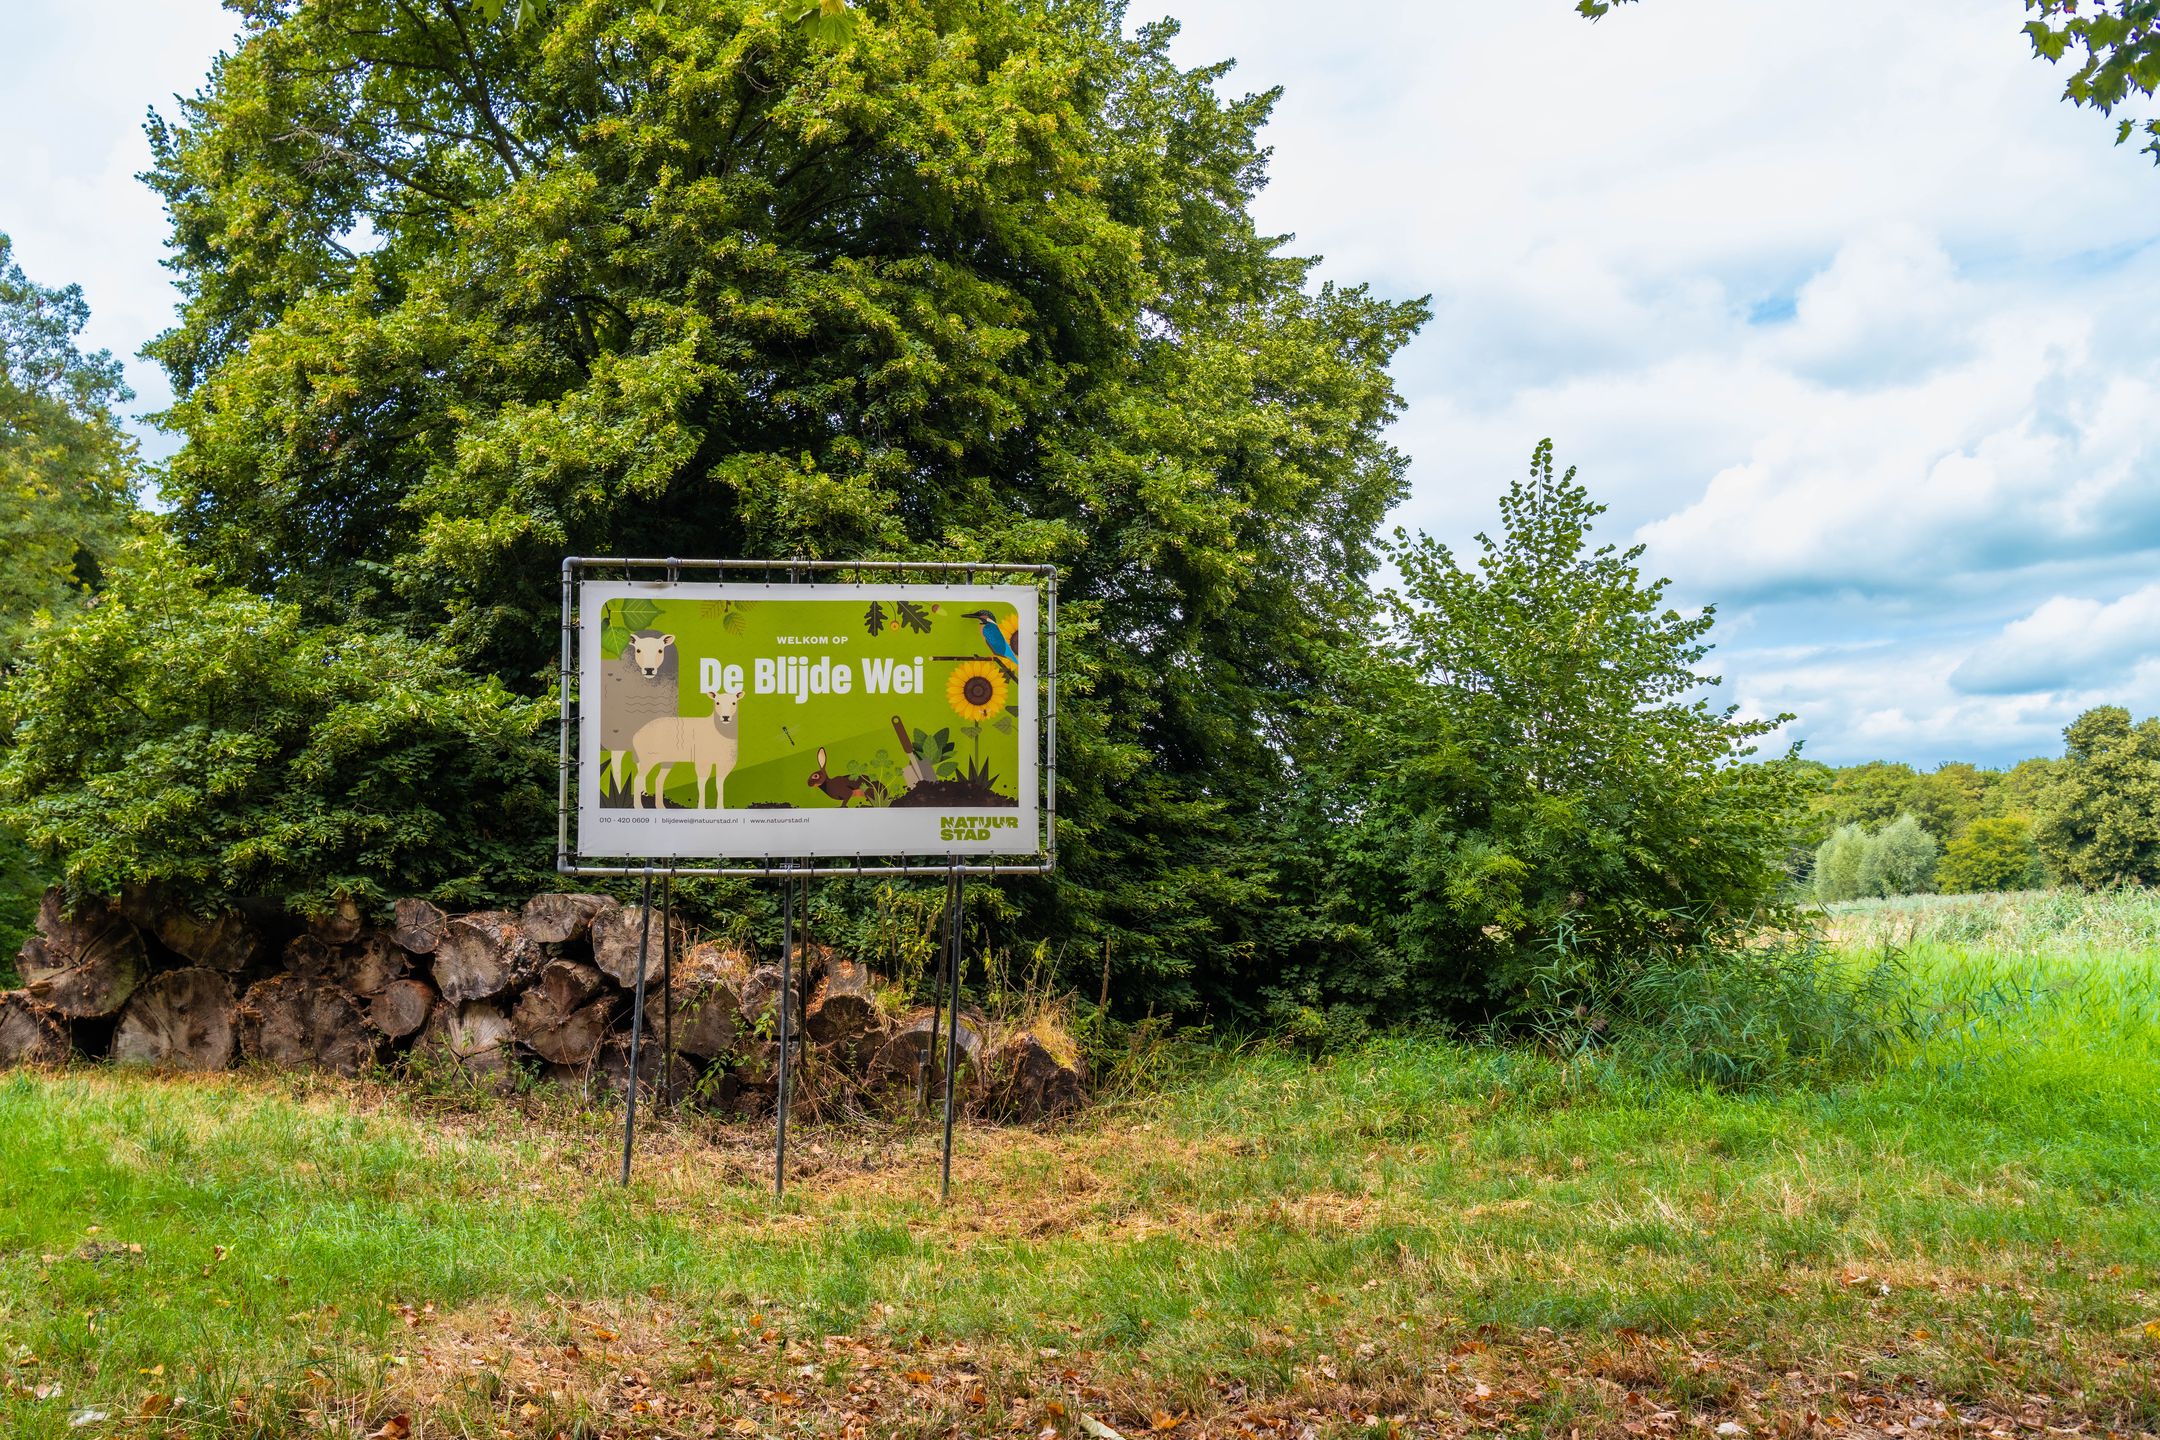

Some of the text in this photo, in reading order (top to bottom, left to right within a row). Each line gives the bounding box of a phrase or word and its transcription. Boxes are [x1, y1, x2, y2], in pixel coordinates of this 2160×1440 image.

[776, 636, 849, 645] WELKOM OP
[699, 655, 924, 705] De Blijde Wei
[940, 816, 1019, 829] NATUUR
[940, 828, 991, 841] STAD
